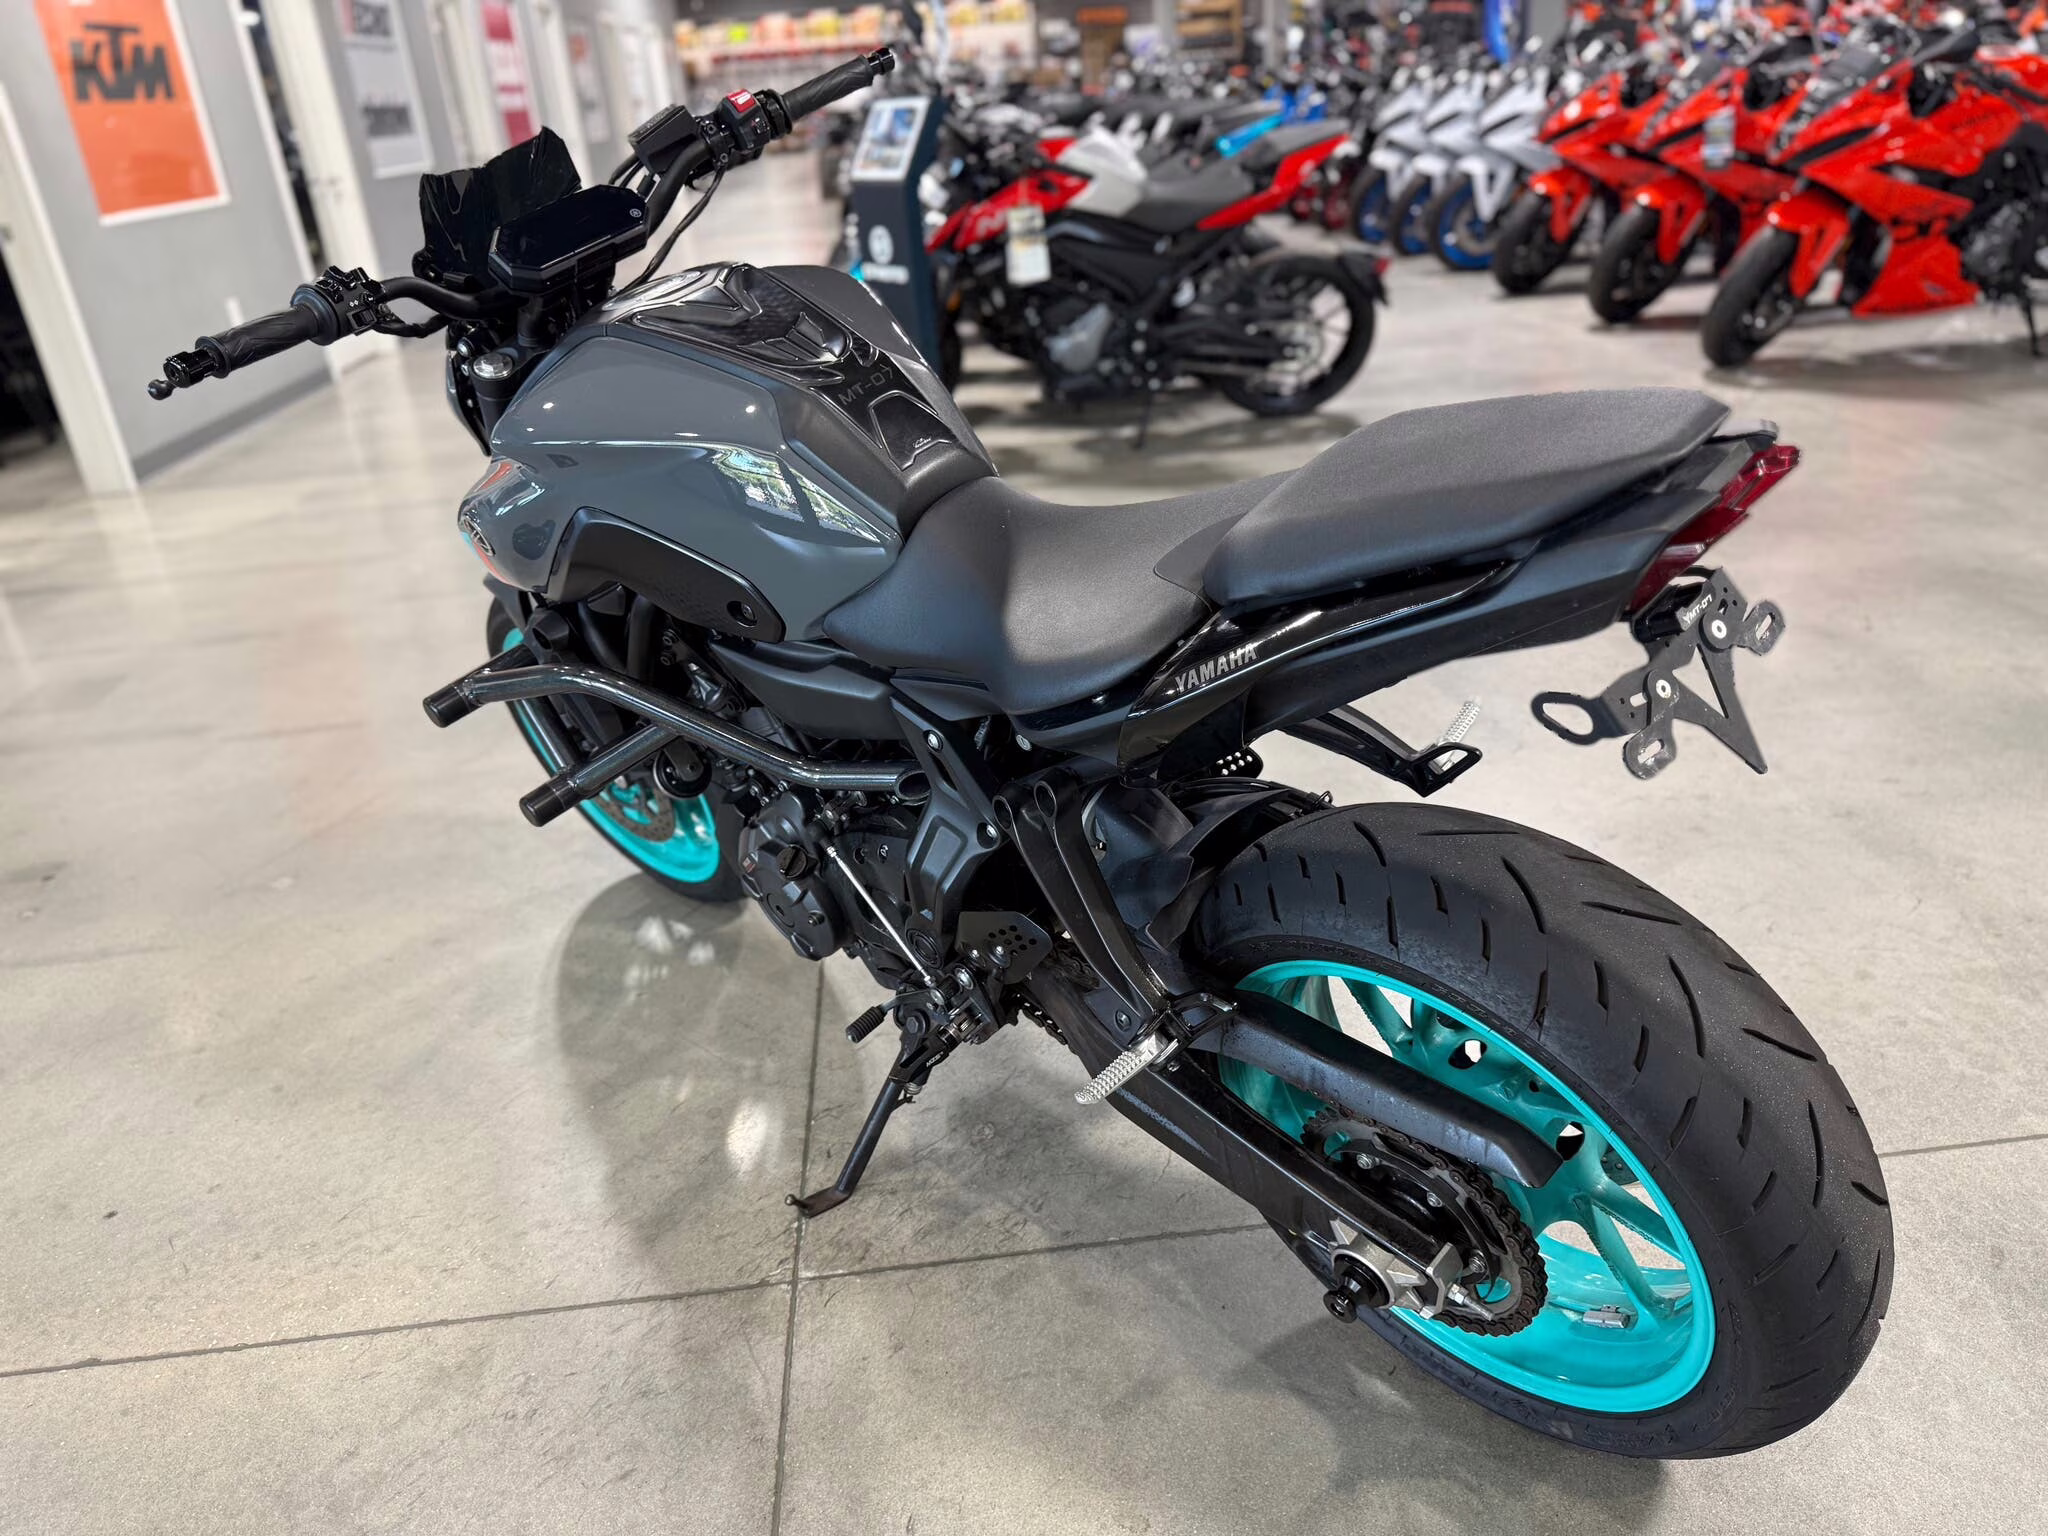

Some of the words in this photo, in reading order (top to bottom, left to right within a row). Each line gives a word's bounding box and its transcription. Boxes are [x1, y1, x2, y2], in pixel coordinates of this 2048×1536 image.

[71, 22, 174, 103] KTM
[838, 363, 893, 405] MT-07
[1175, 643, 1257, 693] YAMAHA
